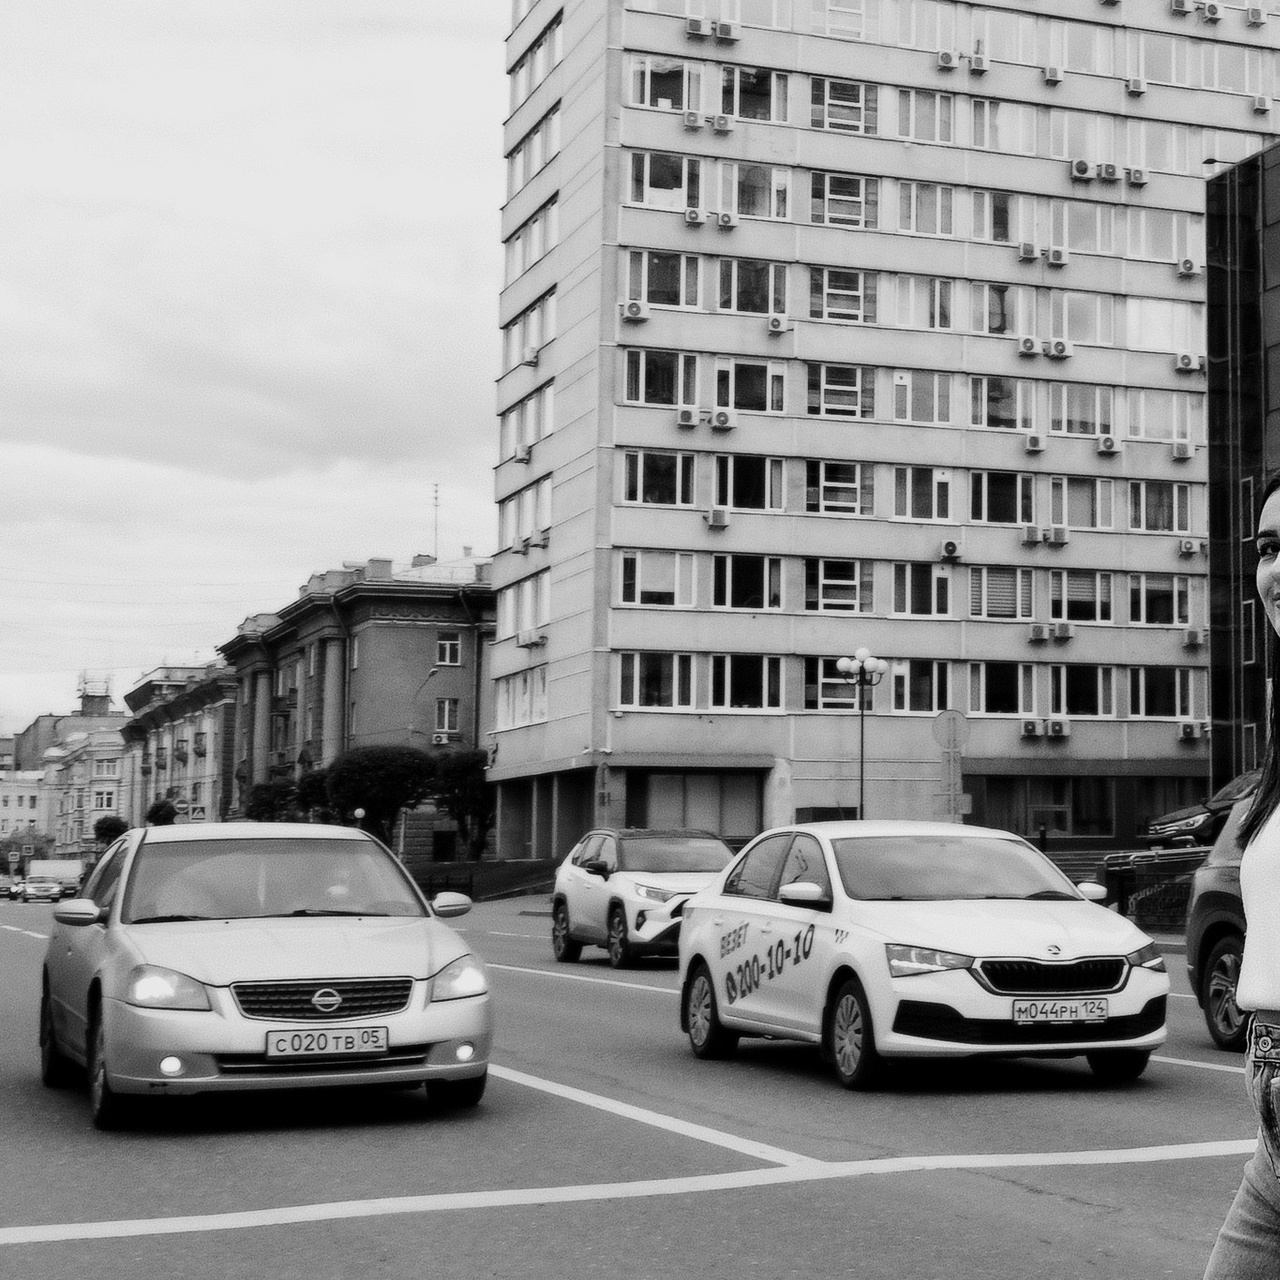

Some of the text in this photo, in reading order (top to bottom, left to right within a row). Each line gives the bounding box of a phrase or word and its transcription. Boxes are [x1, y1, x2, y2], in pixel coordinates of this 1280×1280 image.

[737, 923, 815, 999] 200-10-10
[1082, 1001, 1105, 1014] 124
[361, 1030, 380, 1044] 05
